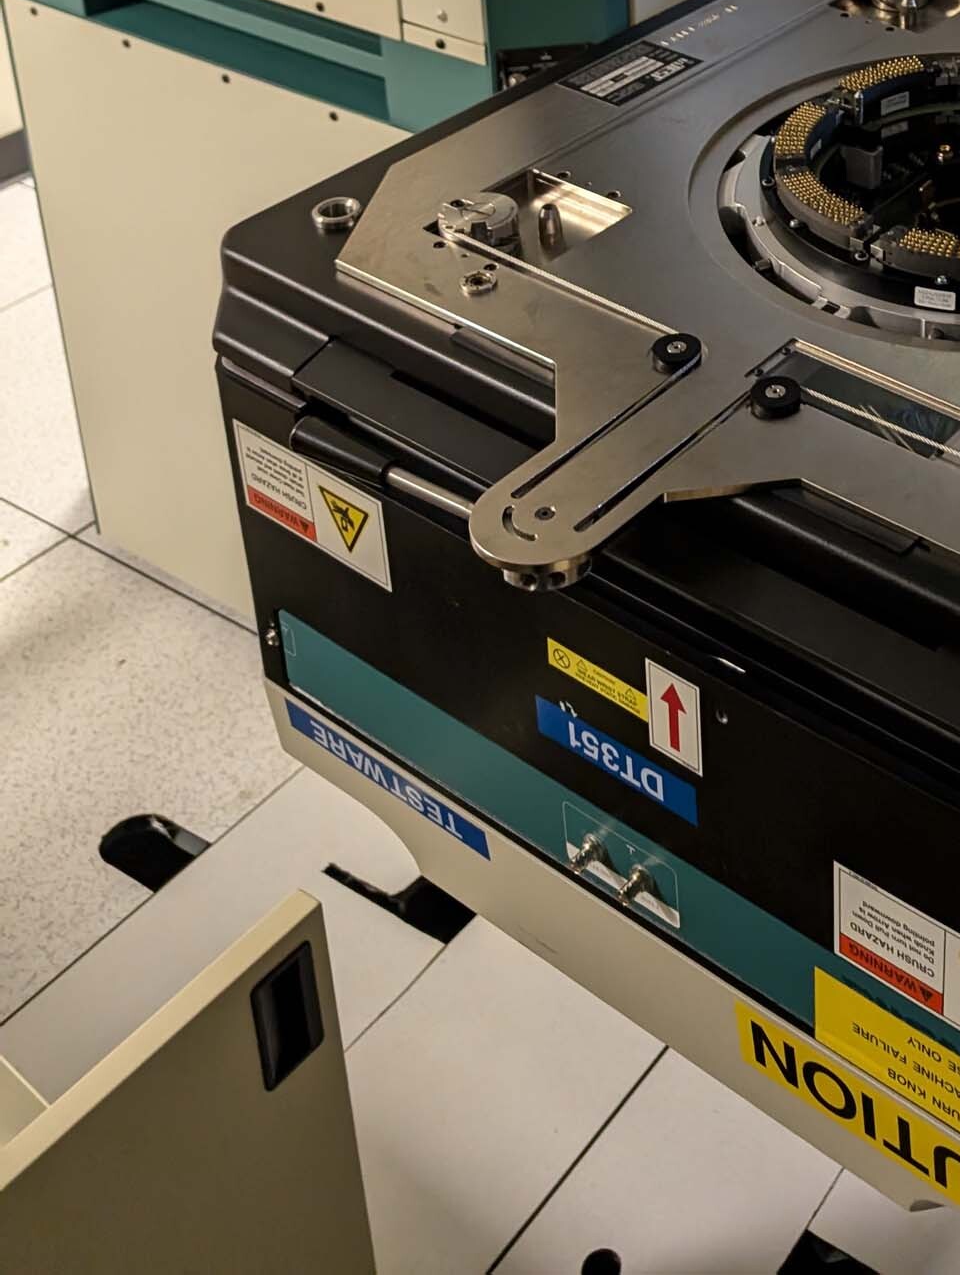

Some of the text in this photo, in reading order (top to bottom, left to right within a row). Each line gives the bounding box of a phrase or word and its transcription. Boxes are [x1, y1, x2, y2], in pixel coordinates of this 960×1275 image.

[310, 718, 464, 840] TESTWARE
[568, 720, 665, 802] DT351
[848, 940, 917, 994] WARNING
[850, 921, 935, 978] CRUSH HAZARD
[851, 1021, 907, 1064] FAILURE
[907, 1035, 942, 1063] ONLY
[886, 1067, 927, 1100] KNOB
